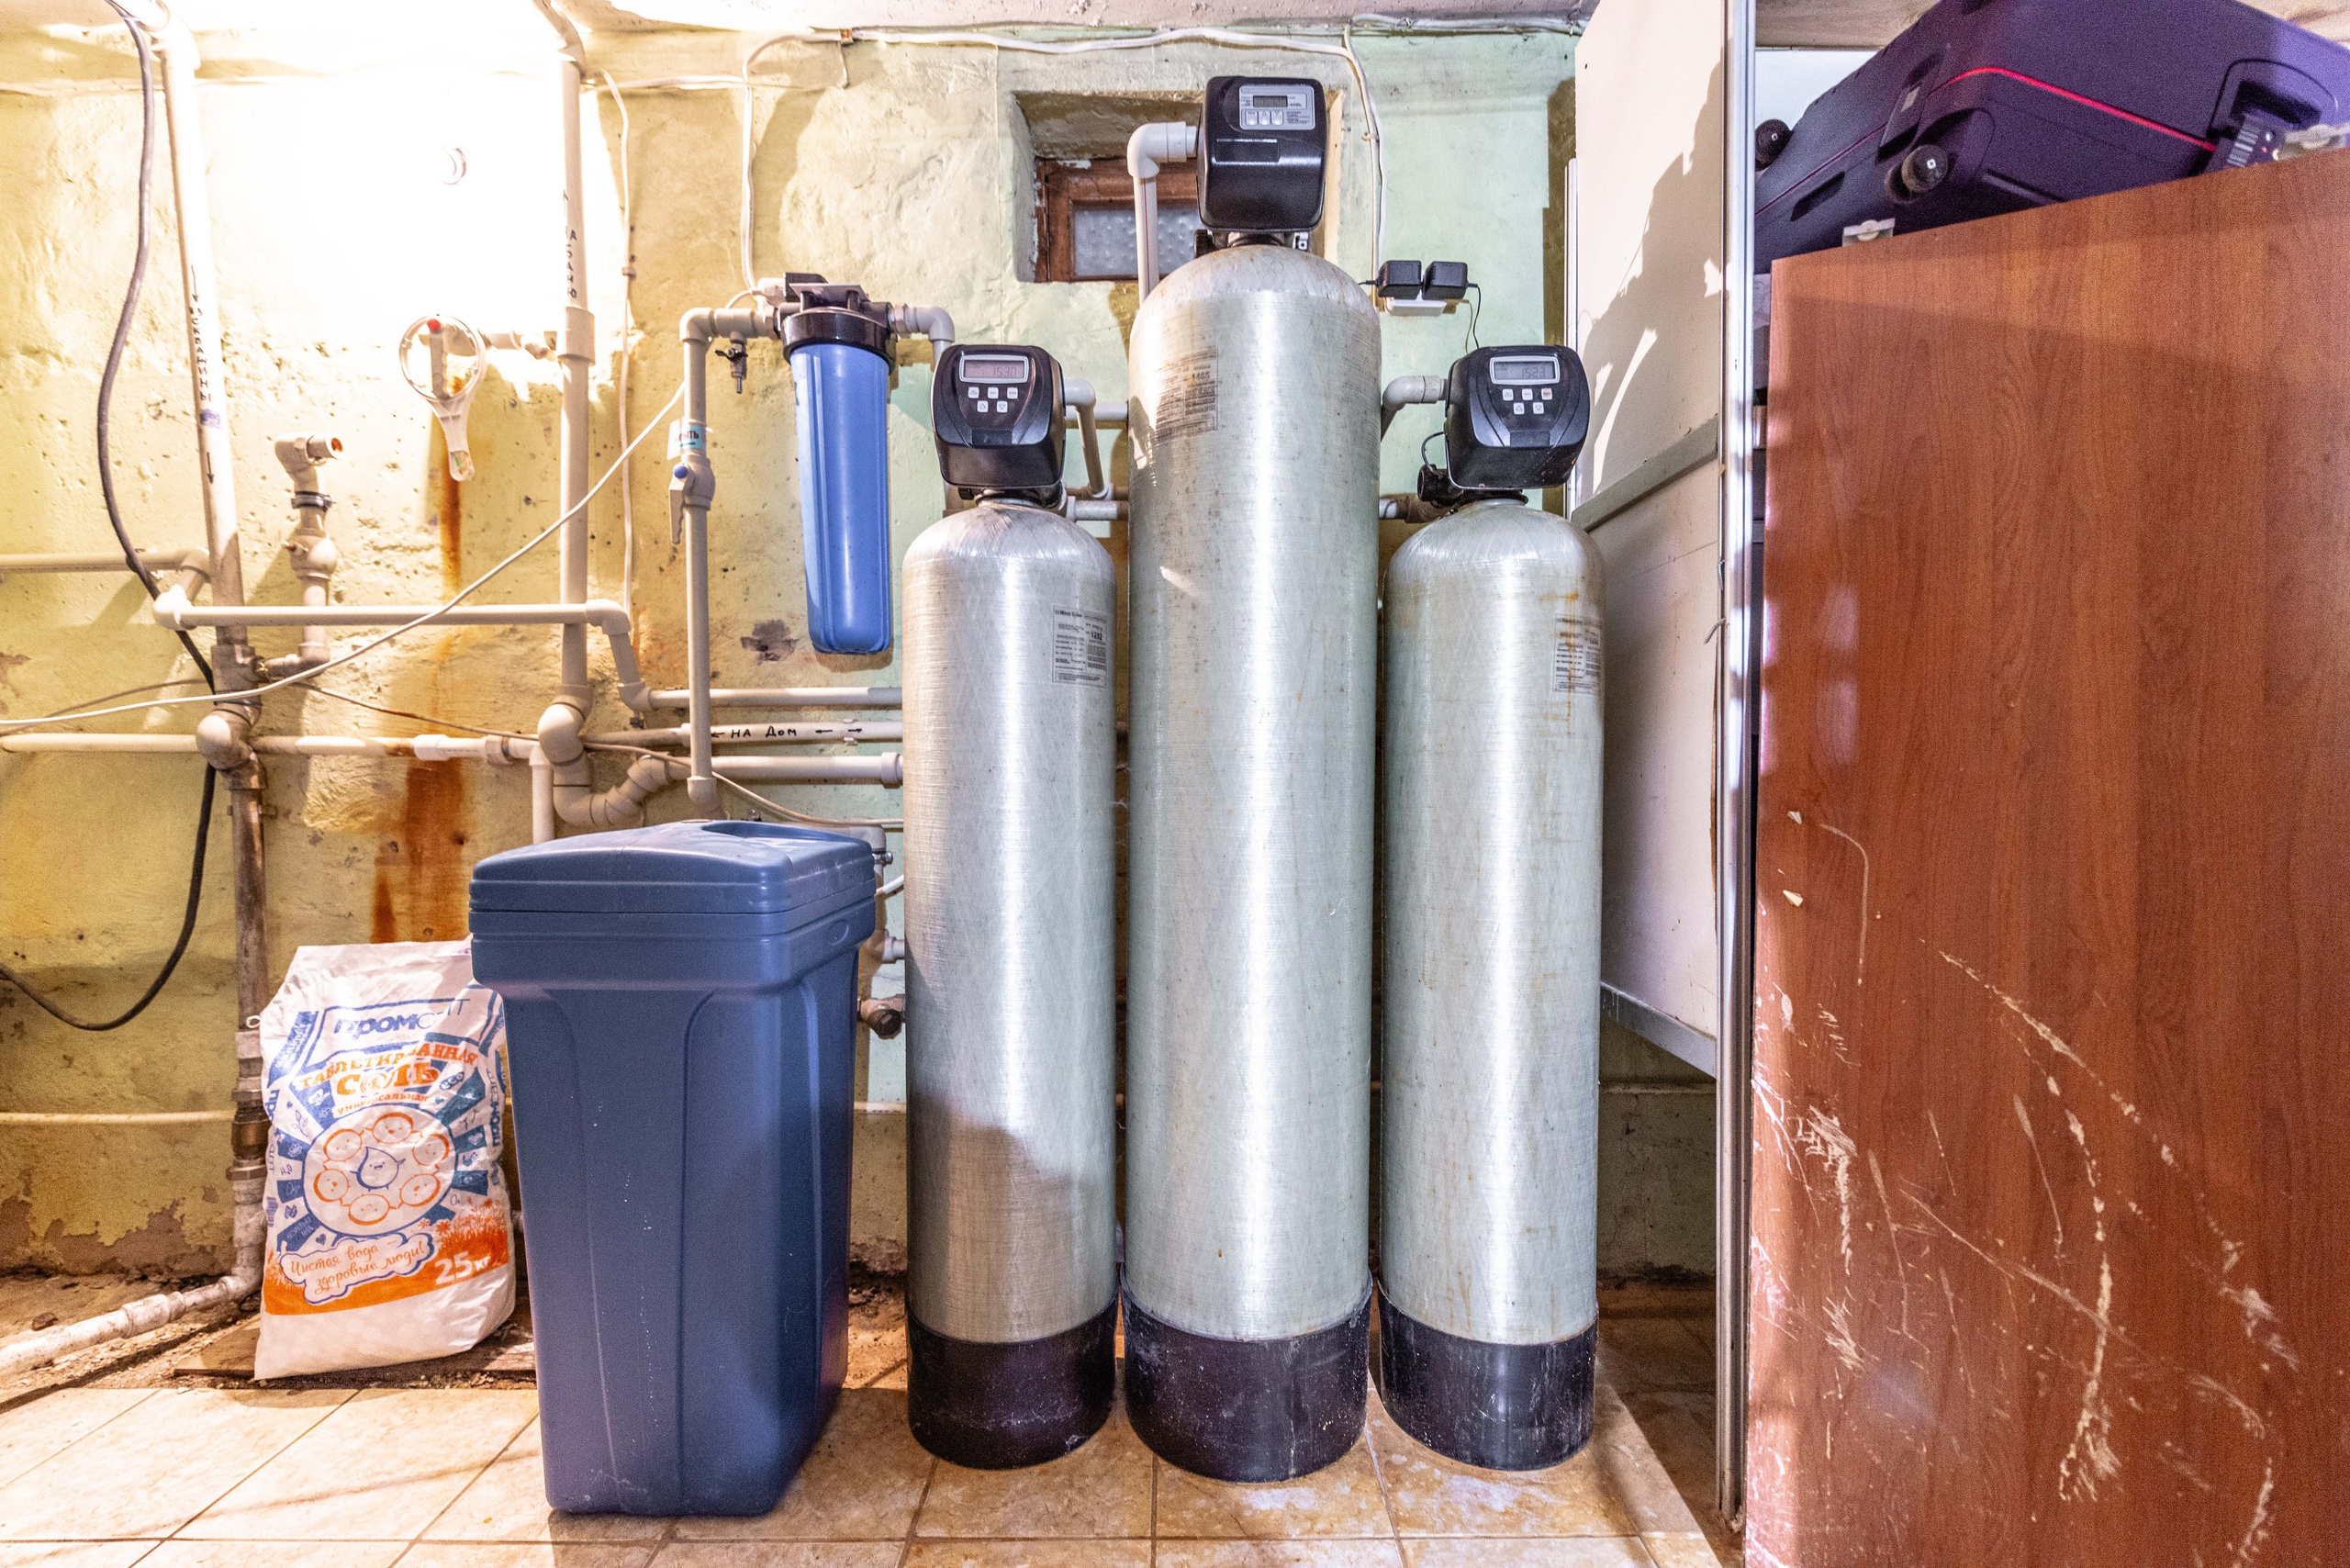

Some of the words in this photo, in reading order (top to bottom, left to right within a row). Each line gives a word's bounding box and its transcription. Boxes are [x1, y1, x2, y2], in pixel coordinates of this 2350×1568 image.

[731, 728, 752, 739] НА
[301, 1043, 478, 1090] ТАБЛЕТИРАННАЯ
[291, 1256, 341, 1276] Чистая
[347, 1244, 379, 1261] вода
[315, 1261, 378, 1294] здоровые
[381, 1241, 426, 1271] люди!
